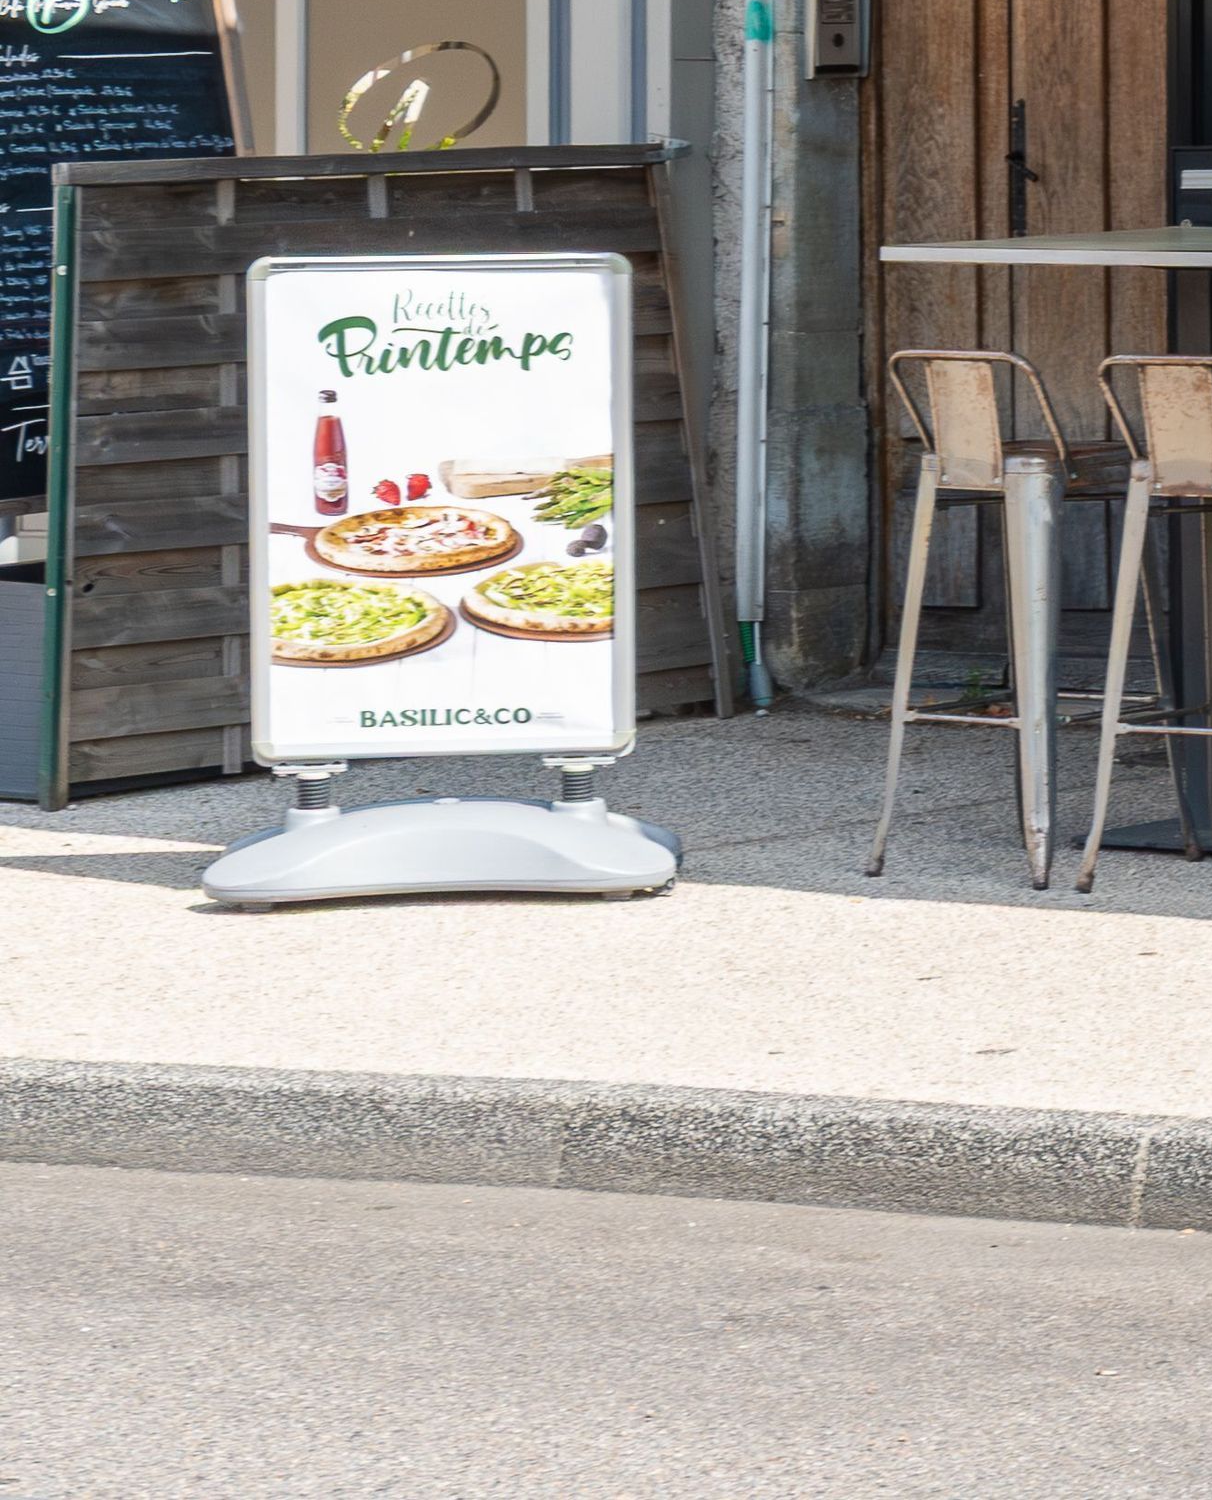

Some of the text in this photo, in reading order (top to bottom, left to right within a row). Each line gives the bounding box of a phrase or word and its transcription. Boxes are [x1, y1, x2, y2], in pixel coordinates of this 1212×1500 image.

[392, 289, 491, 324] Recettes
[318, 315, 574, 378] Printemps
[359, 707, 532, 728] BASILIC&CO
